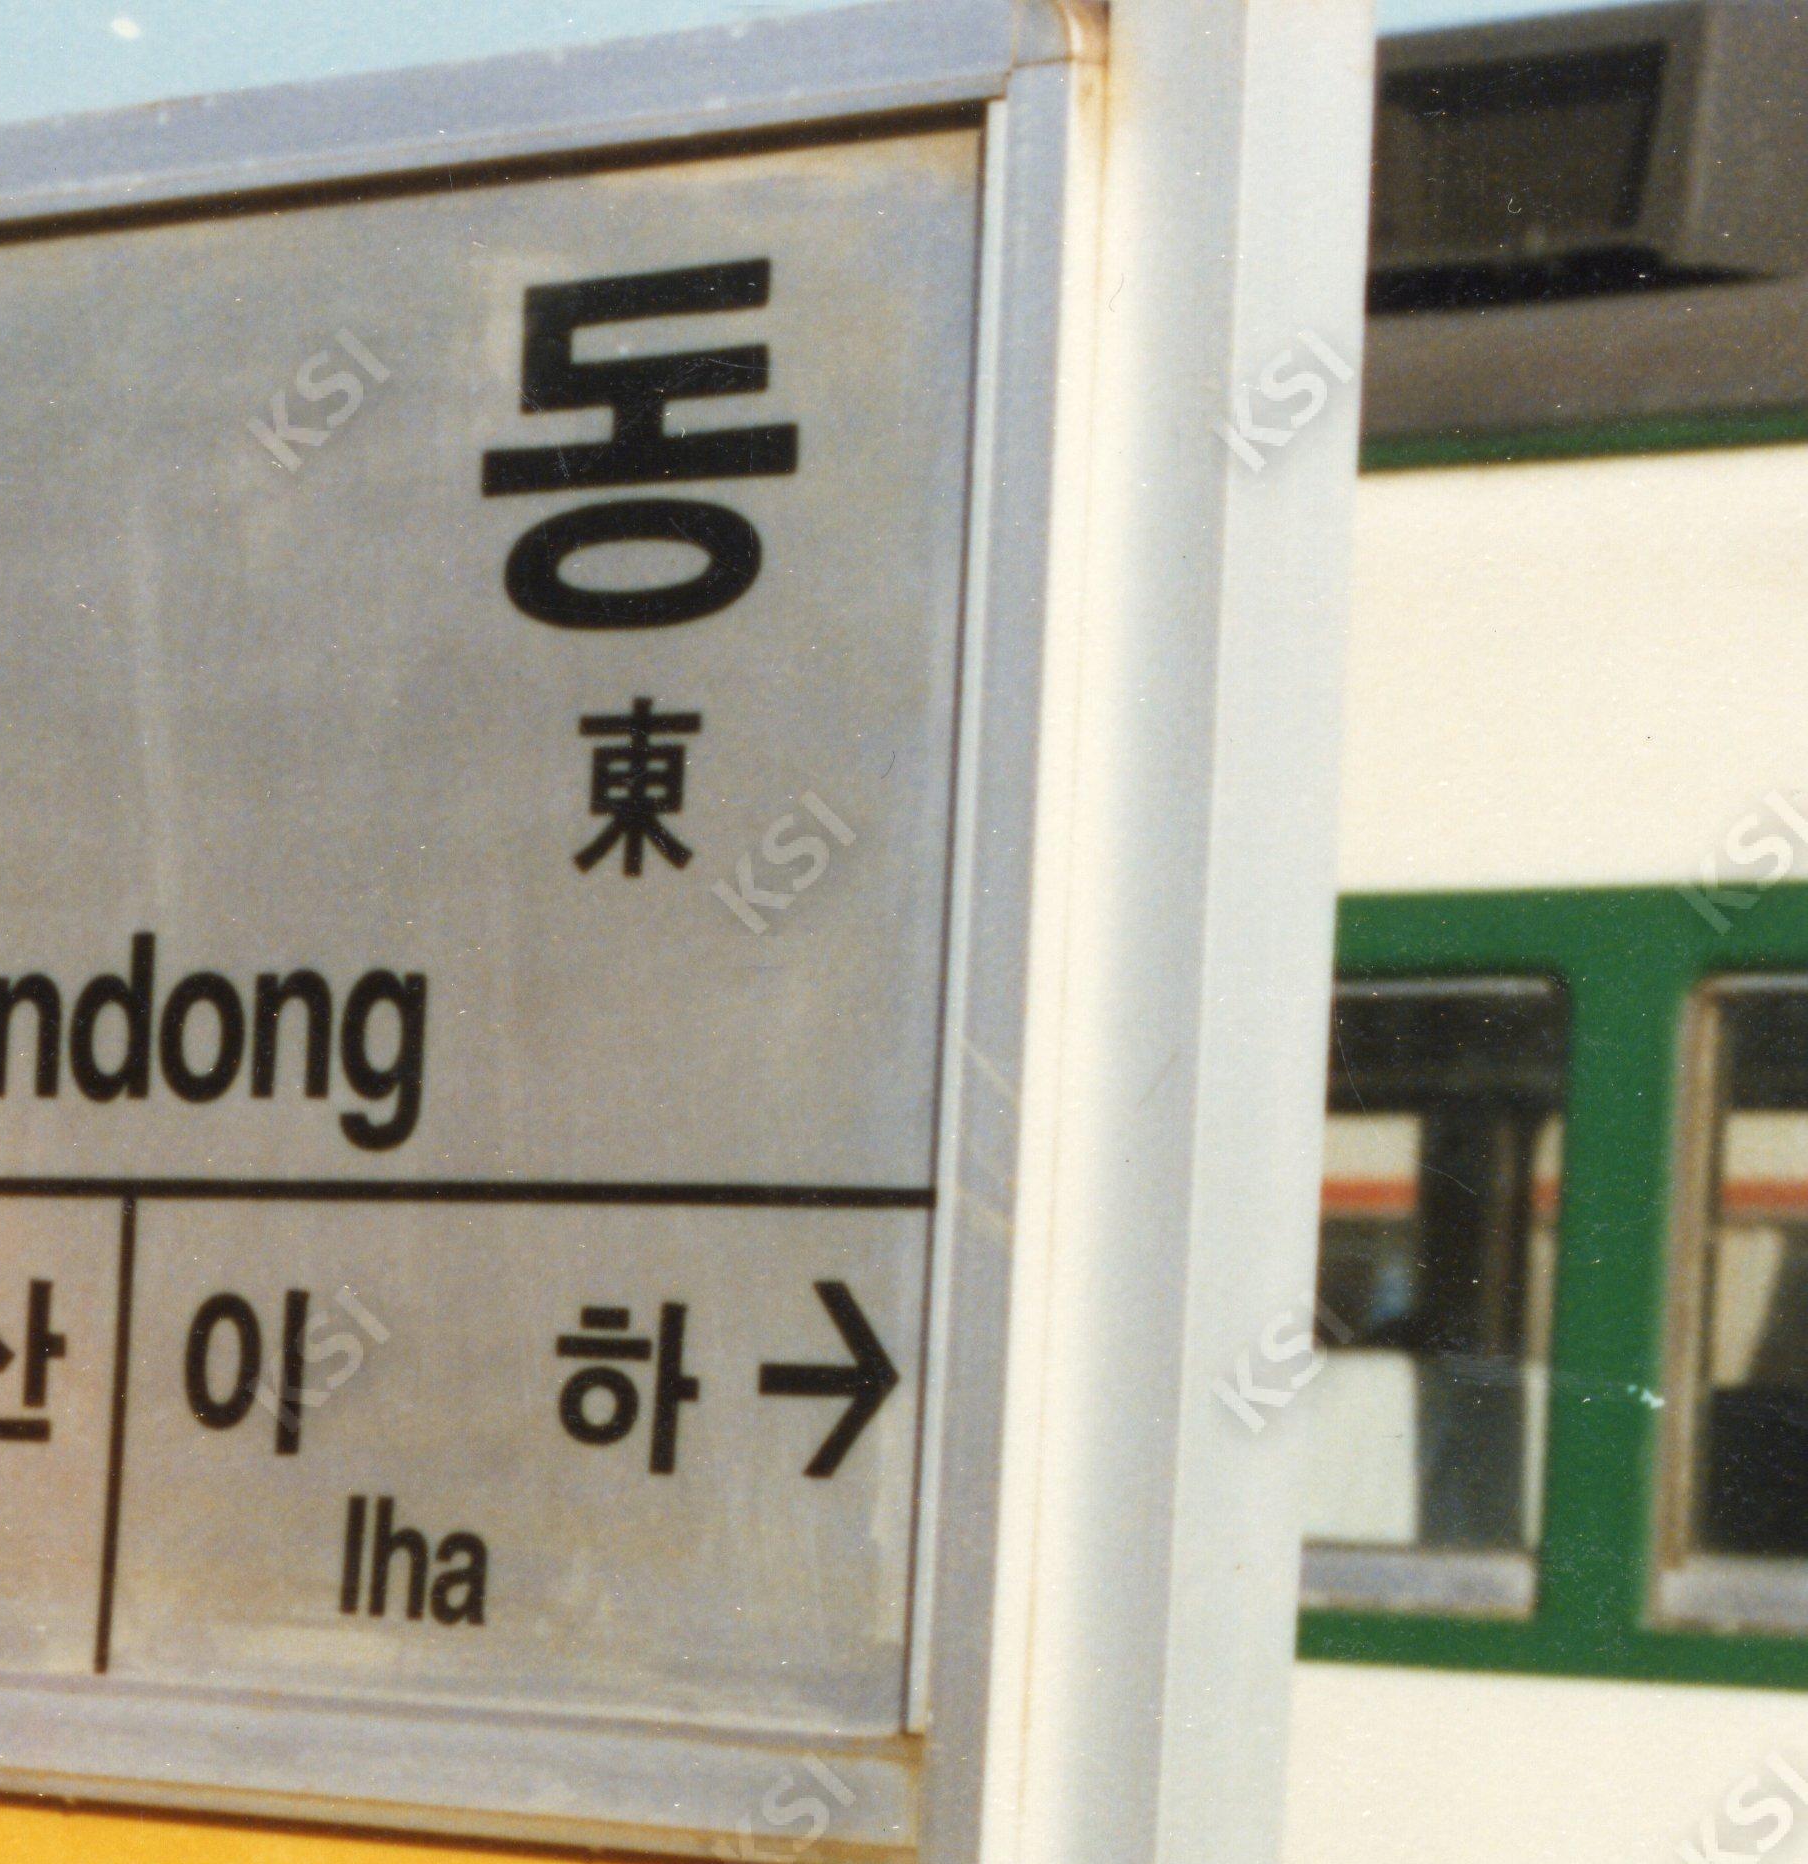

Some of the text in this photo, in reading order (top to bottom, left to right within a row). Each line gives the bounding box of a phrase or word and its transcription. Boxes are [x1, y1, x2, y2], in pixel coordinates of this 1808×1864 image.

[480, 257, 800, 632] 동
[573, 695, 703, 879] 東
[340, 1494, 489, 1626] Iha
